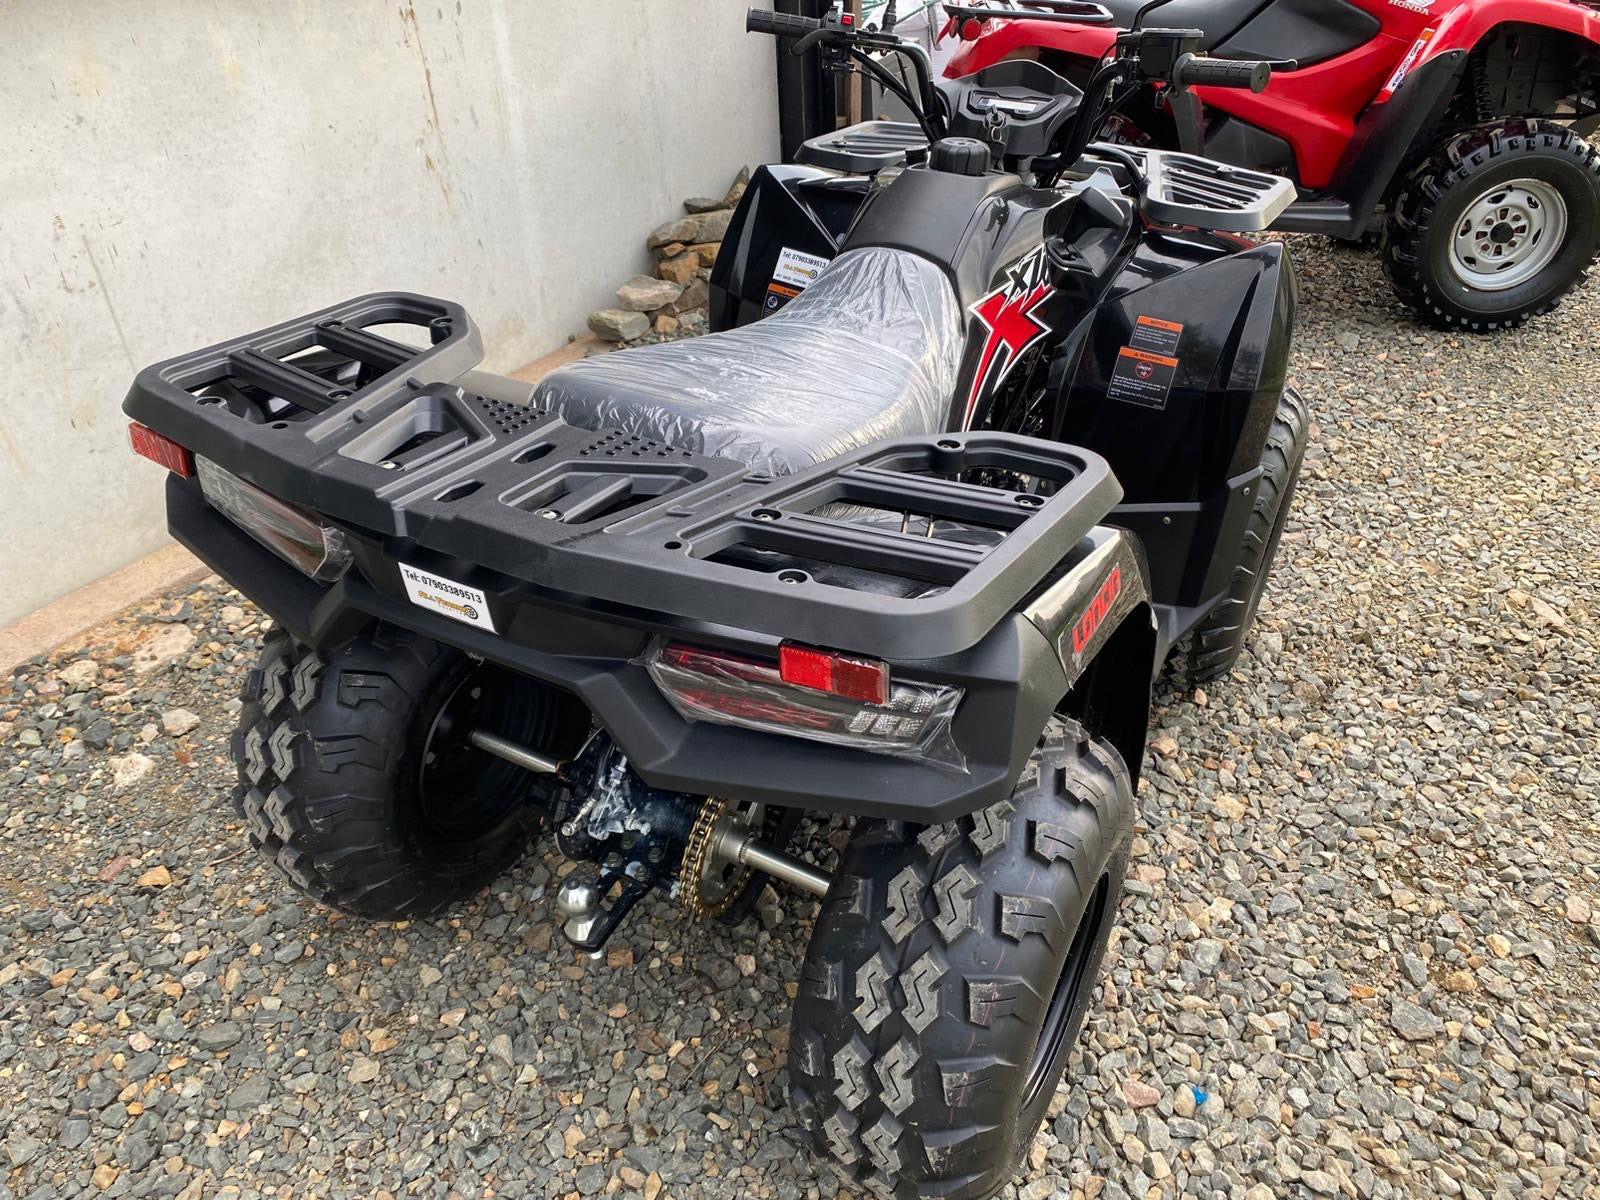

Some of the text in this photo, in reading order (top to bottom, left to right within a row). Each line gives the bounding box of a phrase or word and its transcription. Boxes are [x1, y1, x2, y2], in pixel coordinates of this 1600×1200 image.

[1388, 0, 1429, 15] HONDA
[403, 569, 482, 603] Tel: 07903389513
